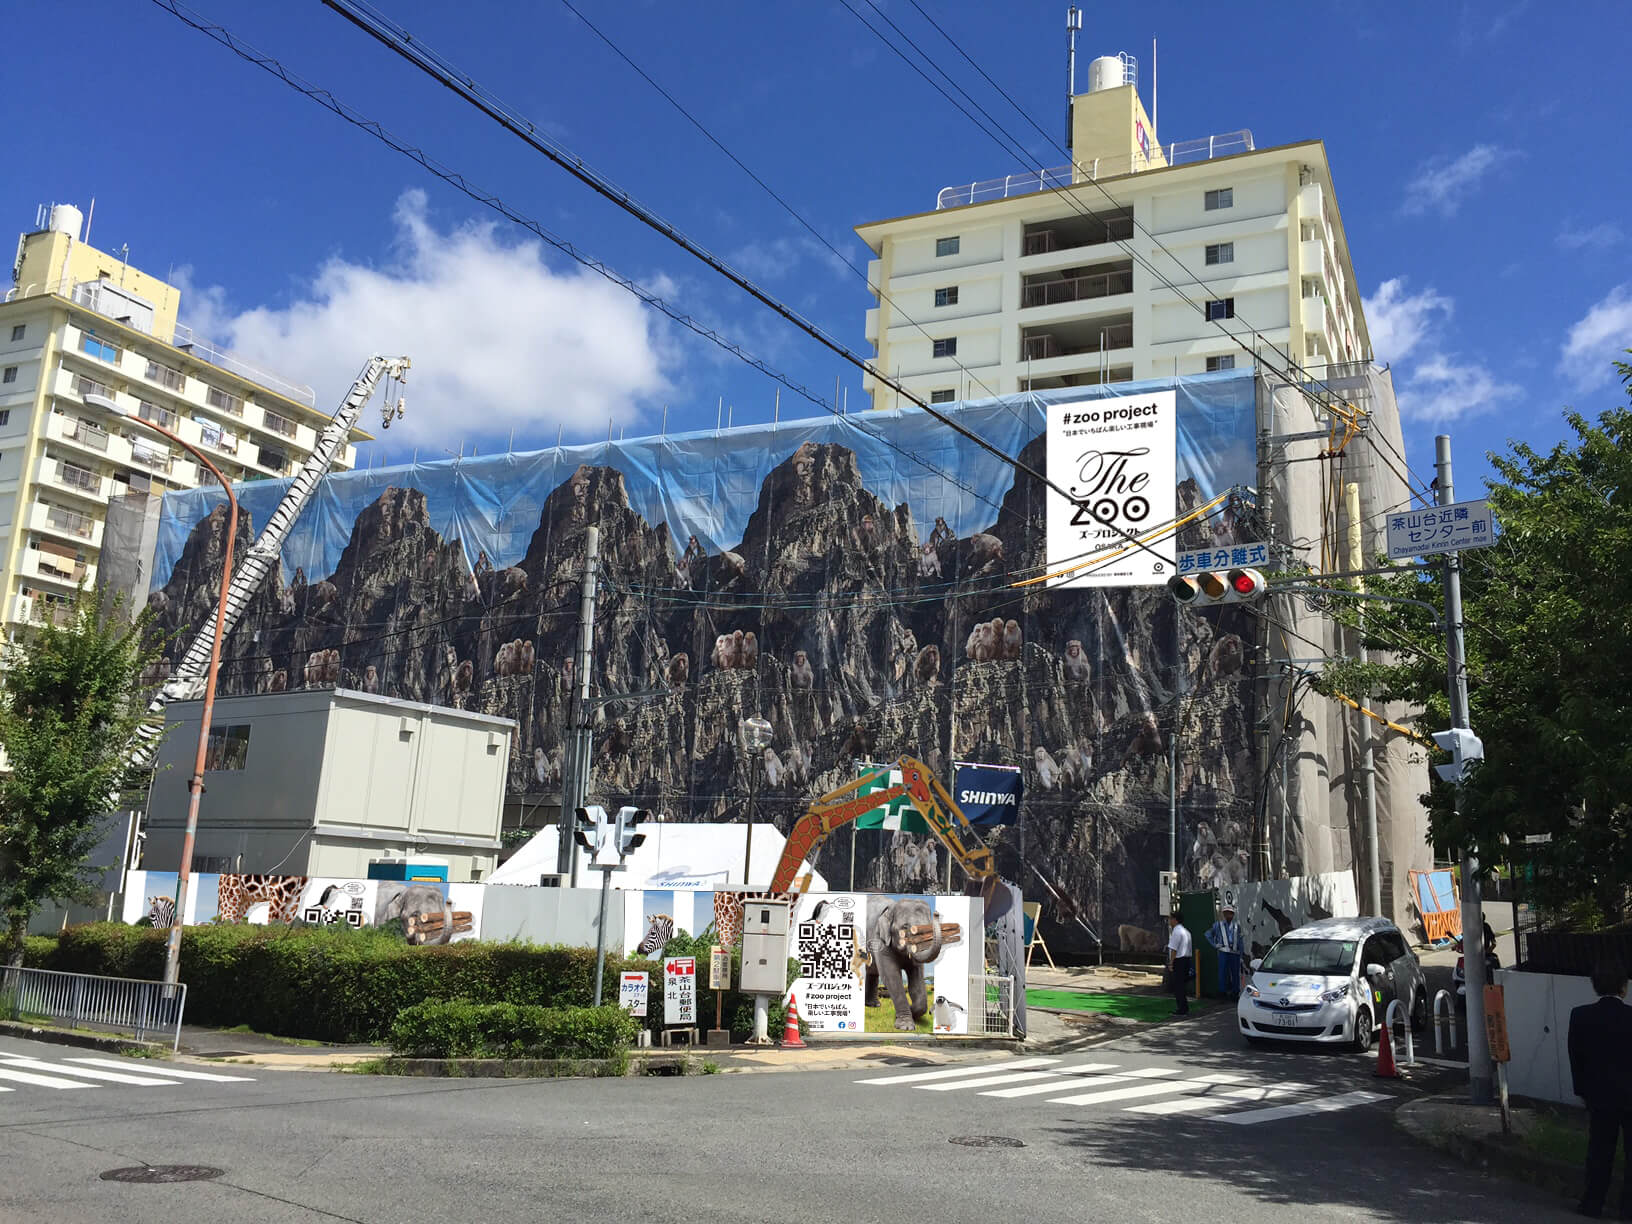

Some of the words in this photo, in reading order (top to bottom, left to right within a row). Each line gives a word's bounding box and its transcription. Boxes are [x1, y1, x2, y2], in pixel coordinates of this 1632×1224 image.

[1103, 402, 1158, 423] project
[1070, 447, 1150, 498] The
[1392, 507, 1469, 531] 茶山台近隣
[1408, 519, 1487, 543] センター前
[1179, 544, 1266, 572] 歩車分離式
[960, 789, 1016, 806] SHINWA
[621, 983, 647, 993] カラオケ
[806, 982, 853, 991] ズープロジェクト
[825, 993, 852, 1001] project
